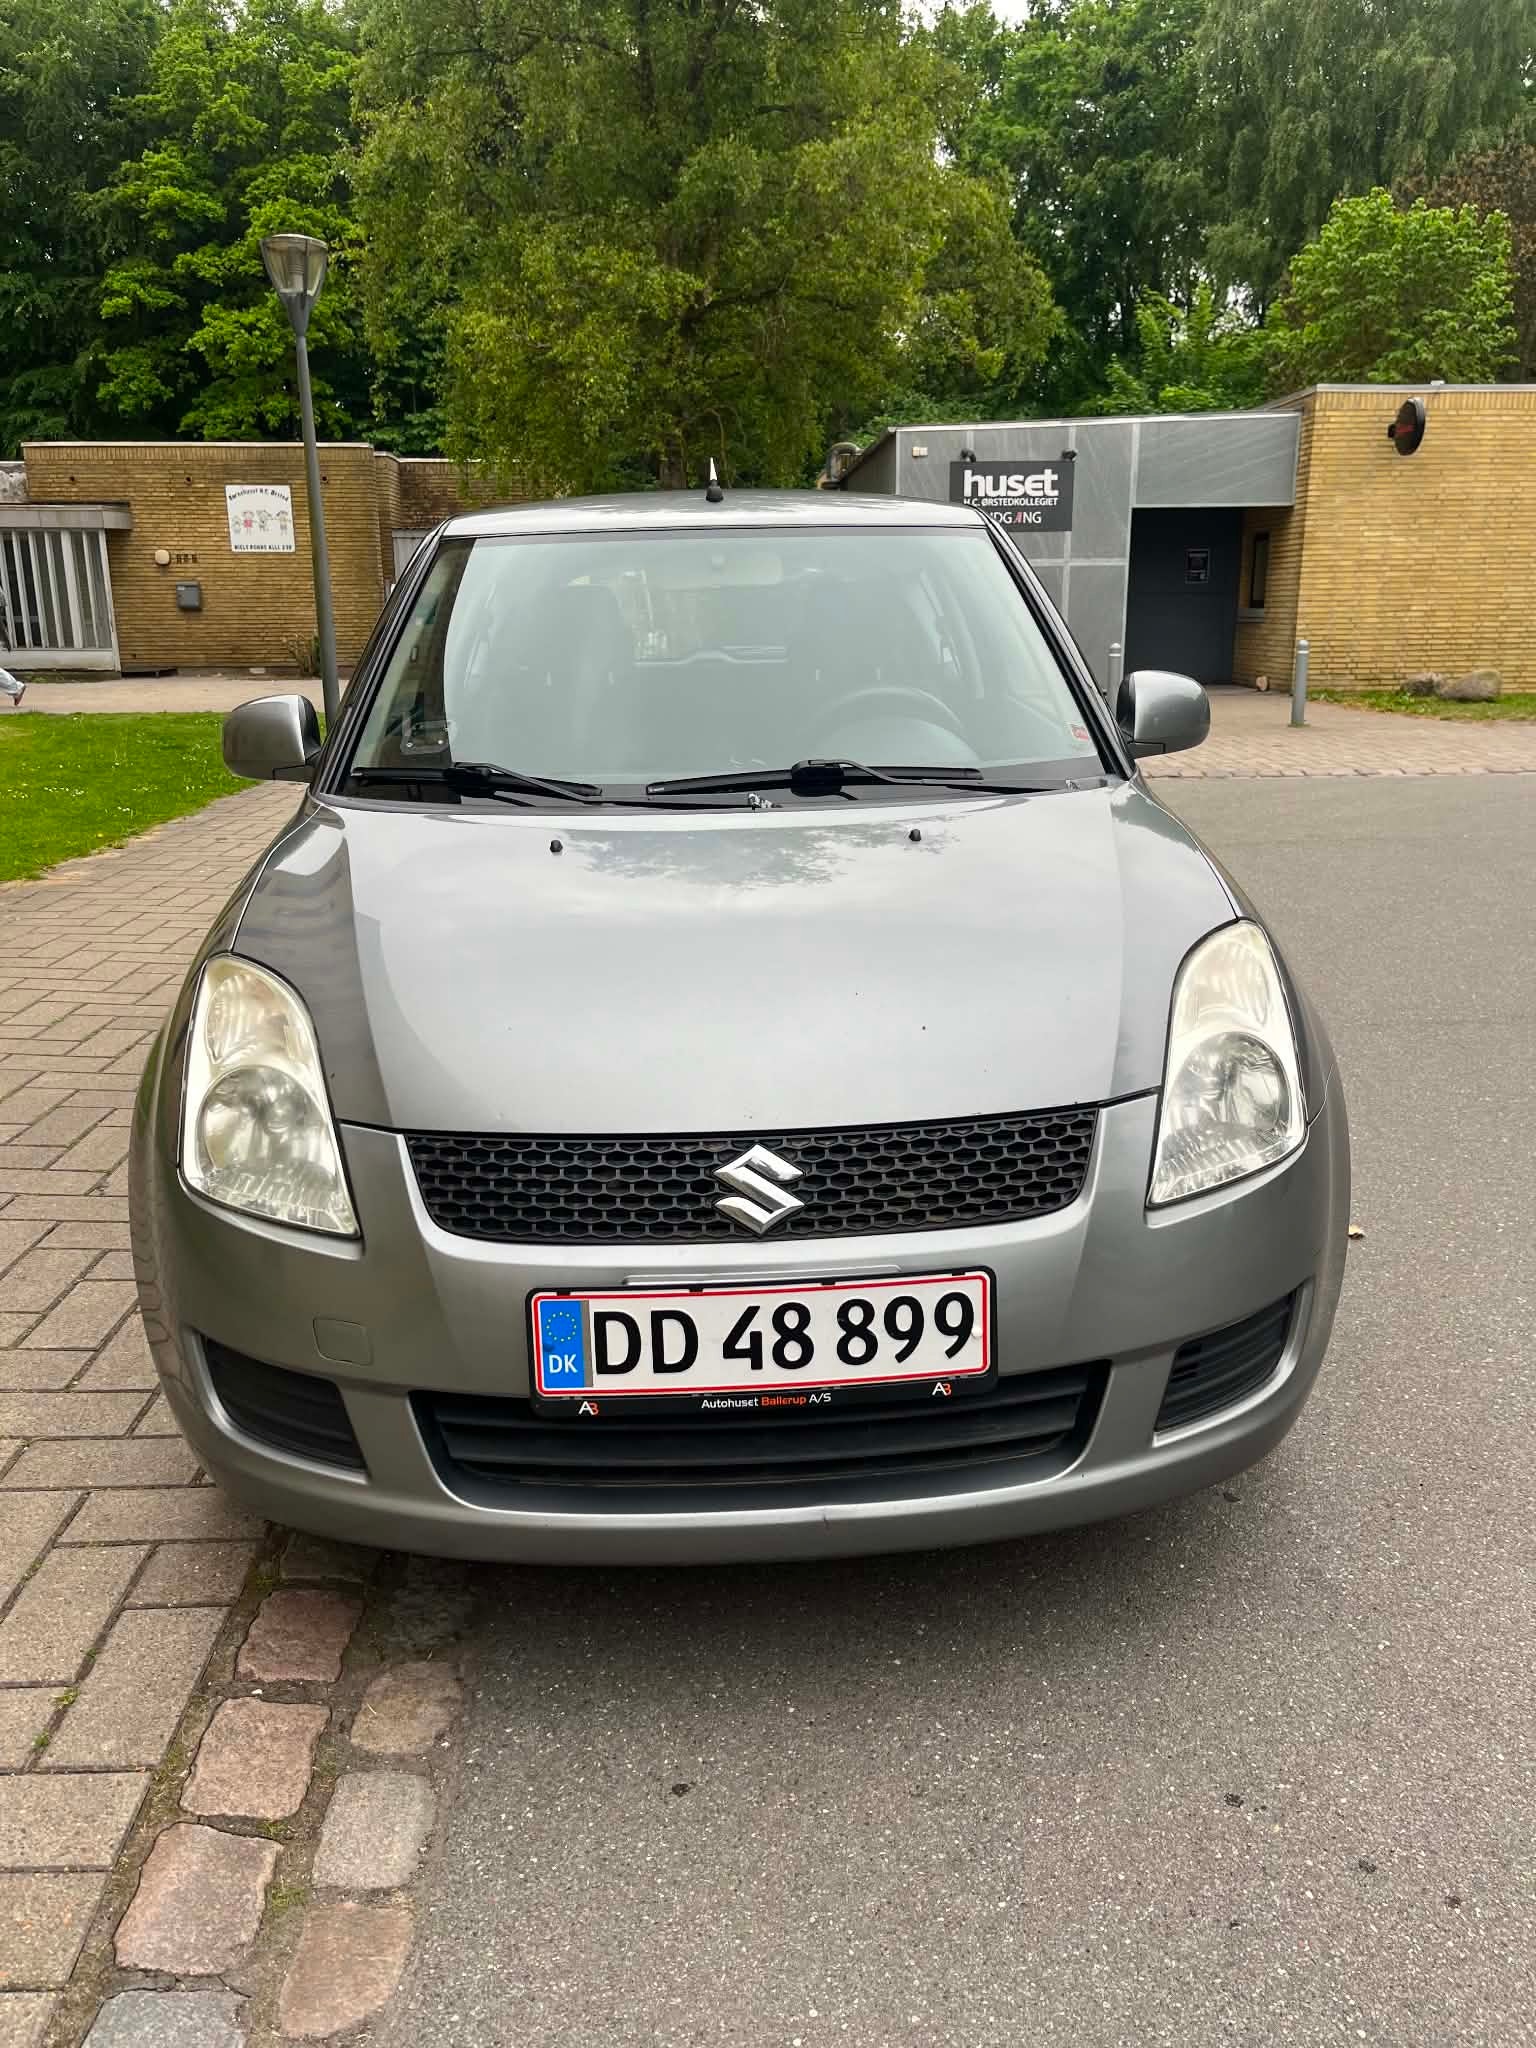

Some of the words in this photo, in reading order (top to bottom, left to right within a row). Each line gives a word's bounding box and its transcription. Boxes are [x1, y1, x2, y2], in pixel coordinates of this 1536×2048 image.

[963, 468, 1059, 497] huset
[981, 497, 1058, 506] ØRSTEDKOLLEGIET
[593, 1309, 699, 1375] DD
[722, 1302, 815, 1370] 48
[836, 1291, 975, 1366] 899
[548, 1354, 578, 1374] DK
[701, 1397, 759, 1410] Autohuset
[761, 1394, 807, 1407] Ballerup
[808, 1392, 832, 1405] A/S
